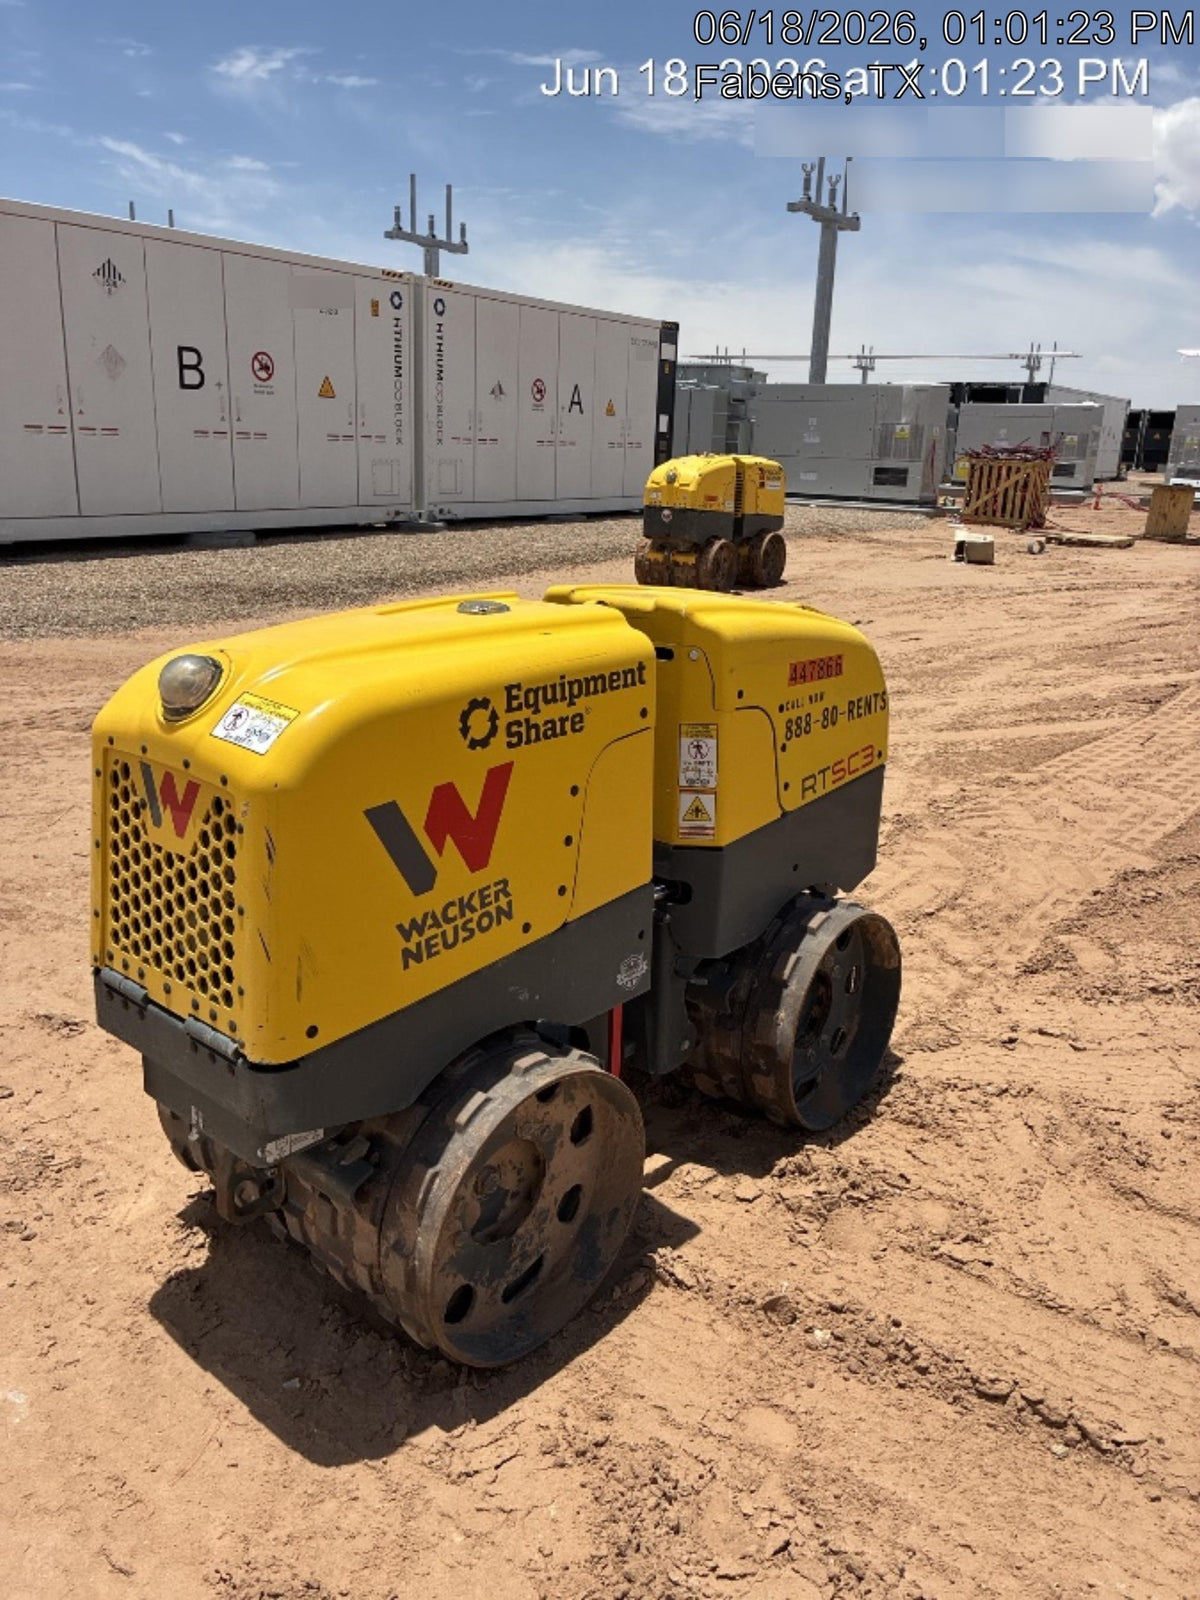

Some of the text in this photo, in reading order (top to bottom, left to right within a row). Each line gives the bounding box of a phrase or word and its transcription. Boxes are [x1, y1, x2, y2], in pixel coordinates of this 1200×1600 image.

[177, 345, 205, 390] B
[568, 384, 584, 414] A
[504, 661, 646, 715] Equipment
[785, 690, 888, 742] 888-80-RENTS
[395, 878, 513, 943] WACKER
[401, 899, 514, 971] NEUSON
